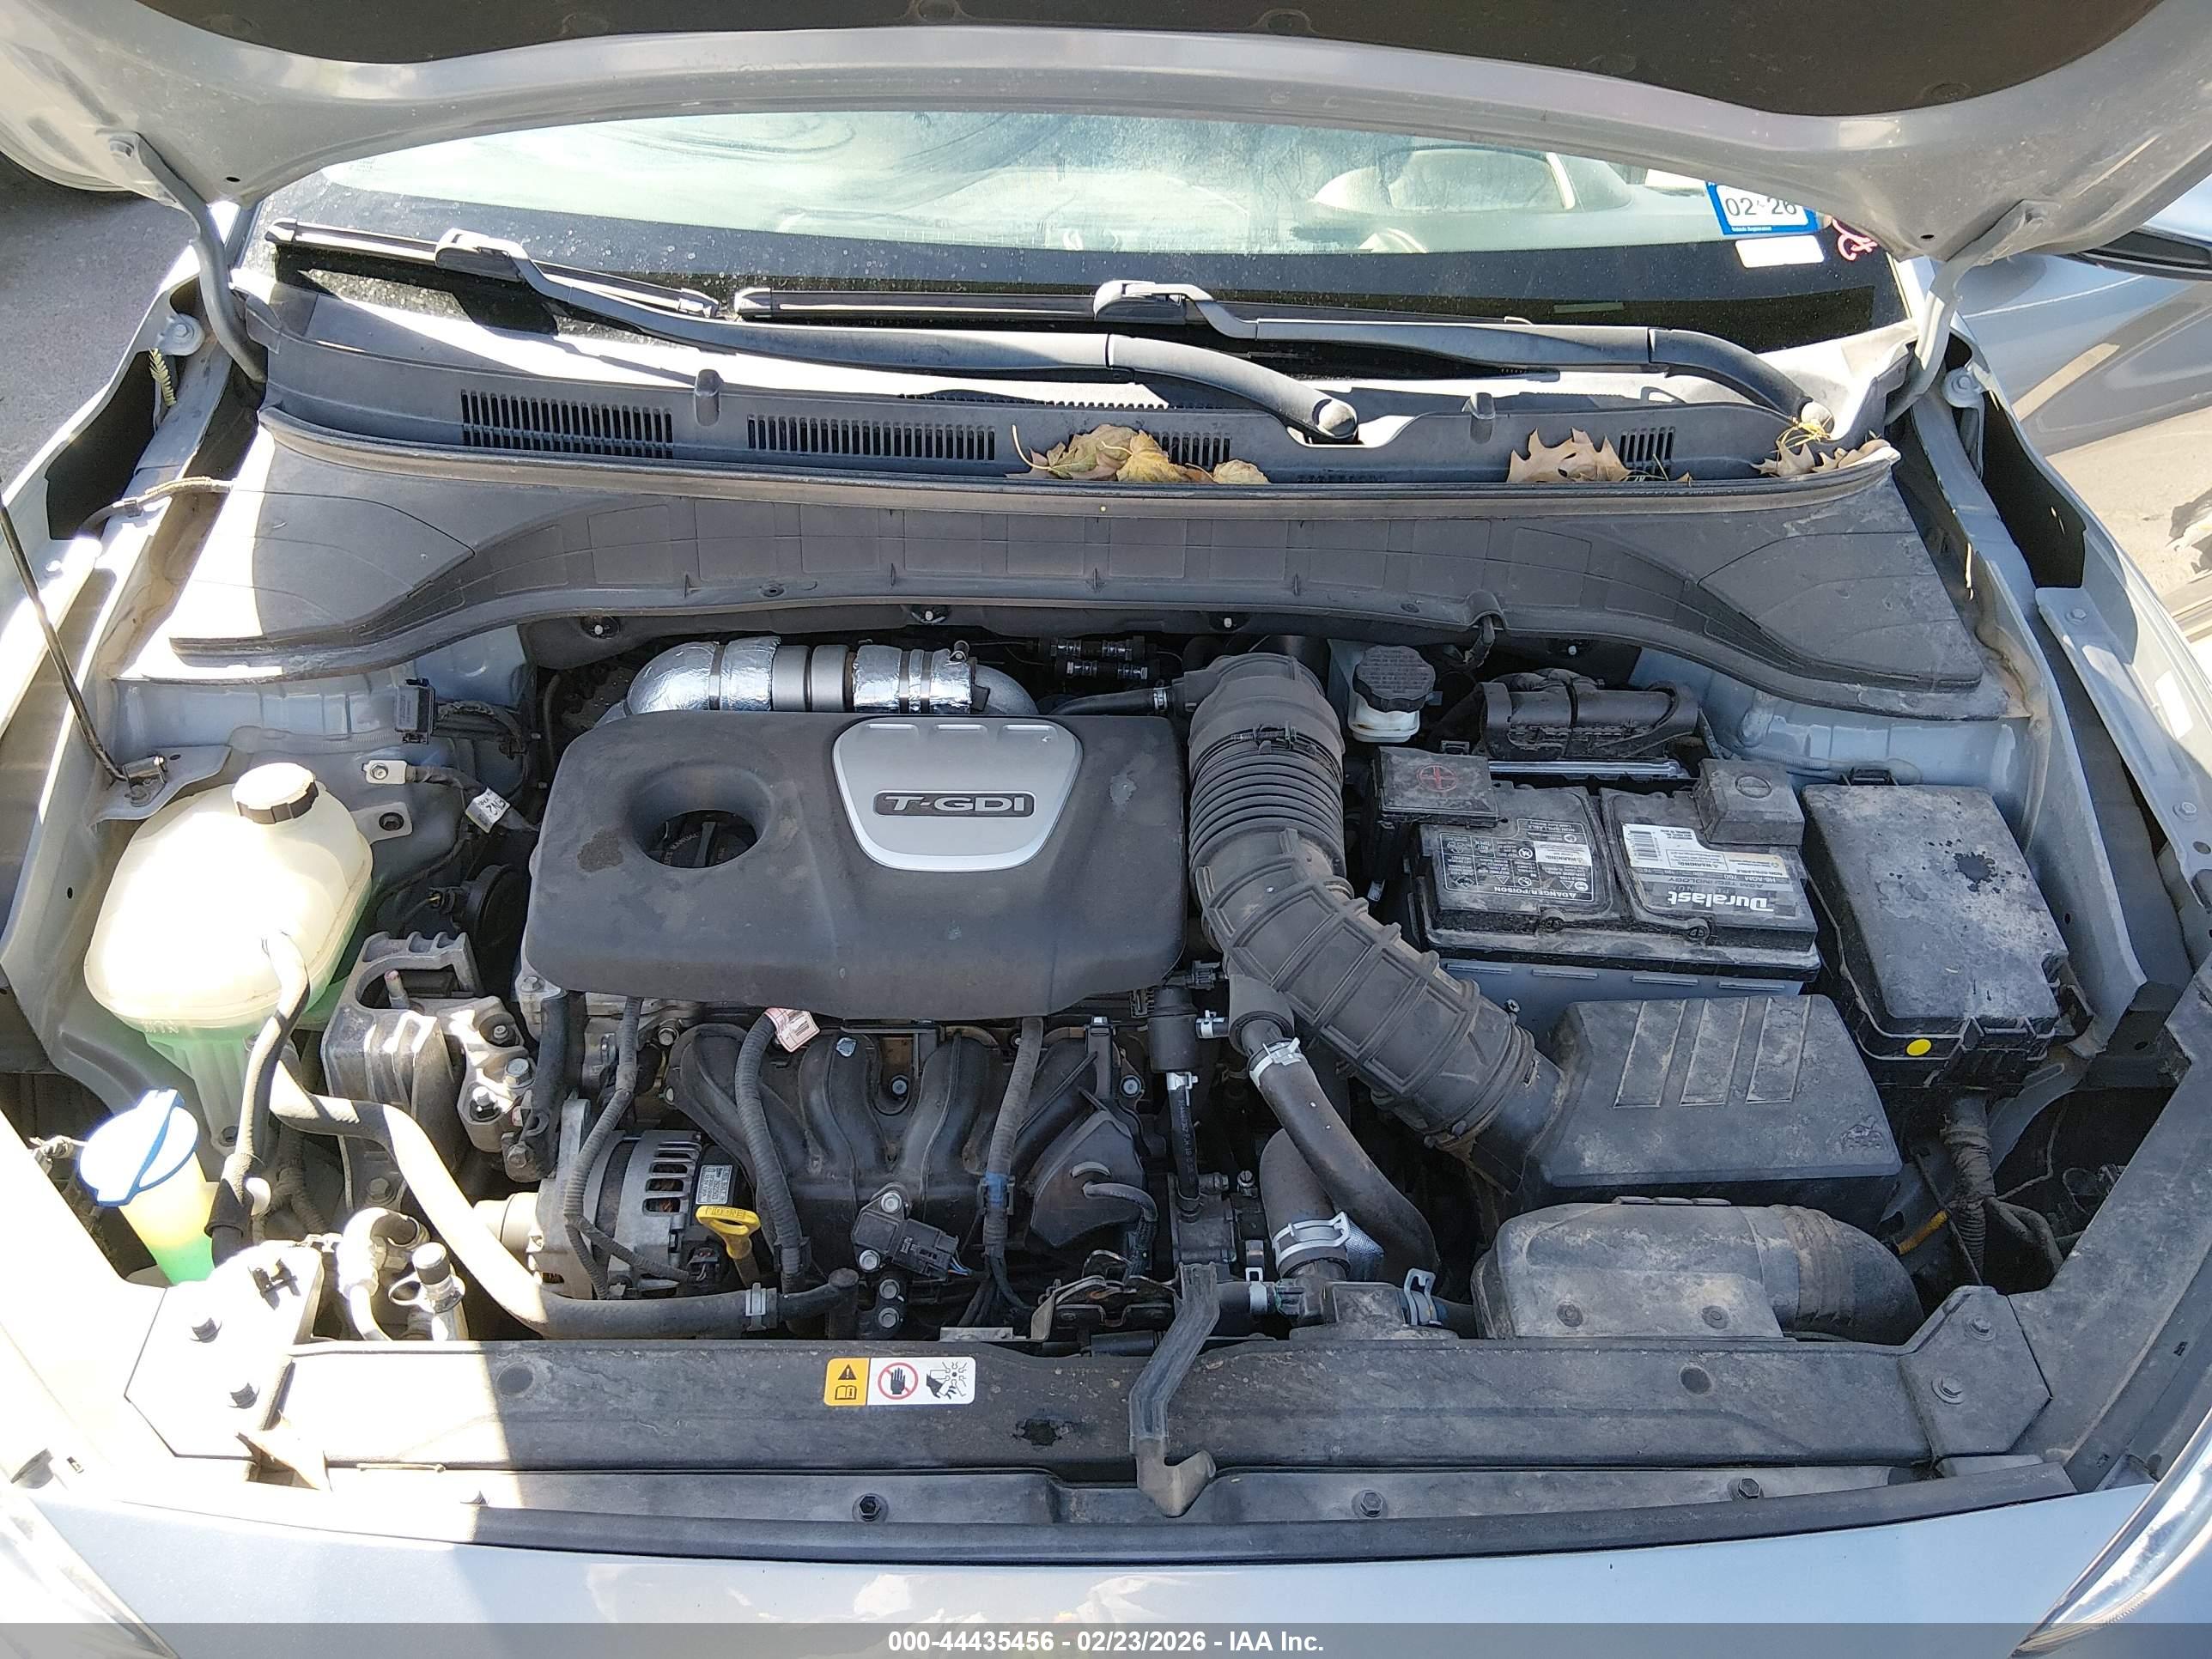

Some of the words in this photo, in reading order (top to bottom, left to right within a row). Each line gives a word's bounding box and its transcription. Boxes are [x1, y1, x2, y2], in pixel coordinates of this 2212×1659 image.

[1725, 198, 1757, 216] 02
[1767, 198, 1797, 216] 26
[885, 796, 1024, 811] T-GDI
[1494, 885, 1569, 897] DANGER/POISON
[1667, 890, 1775, 912] Duralast
